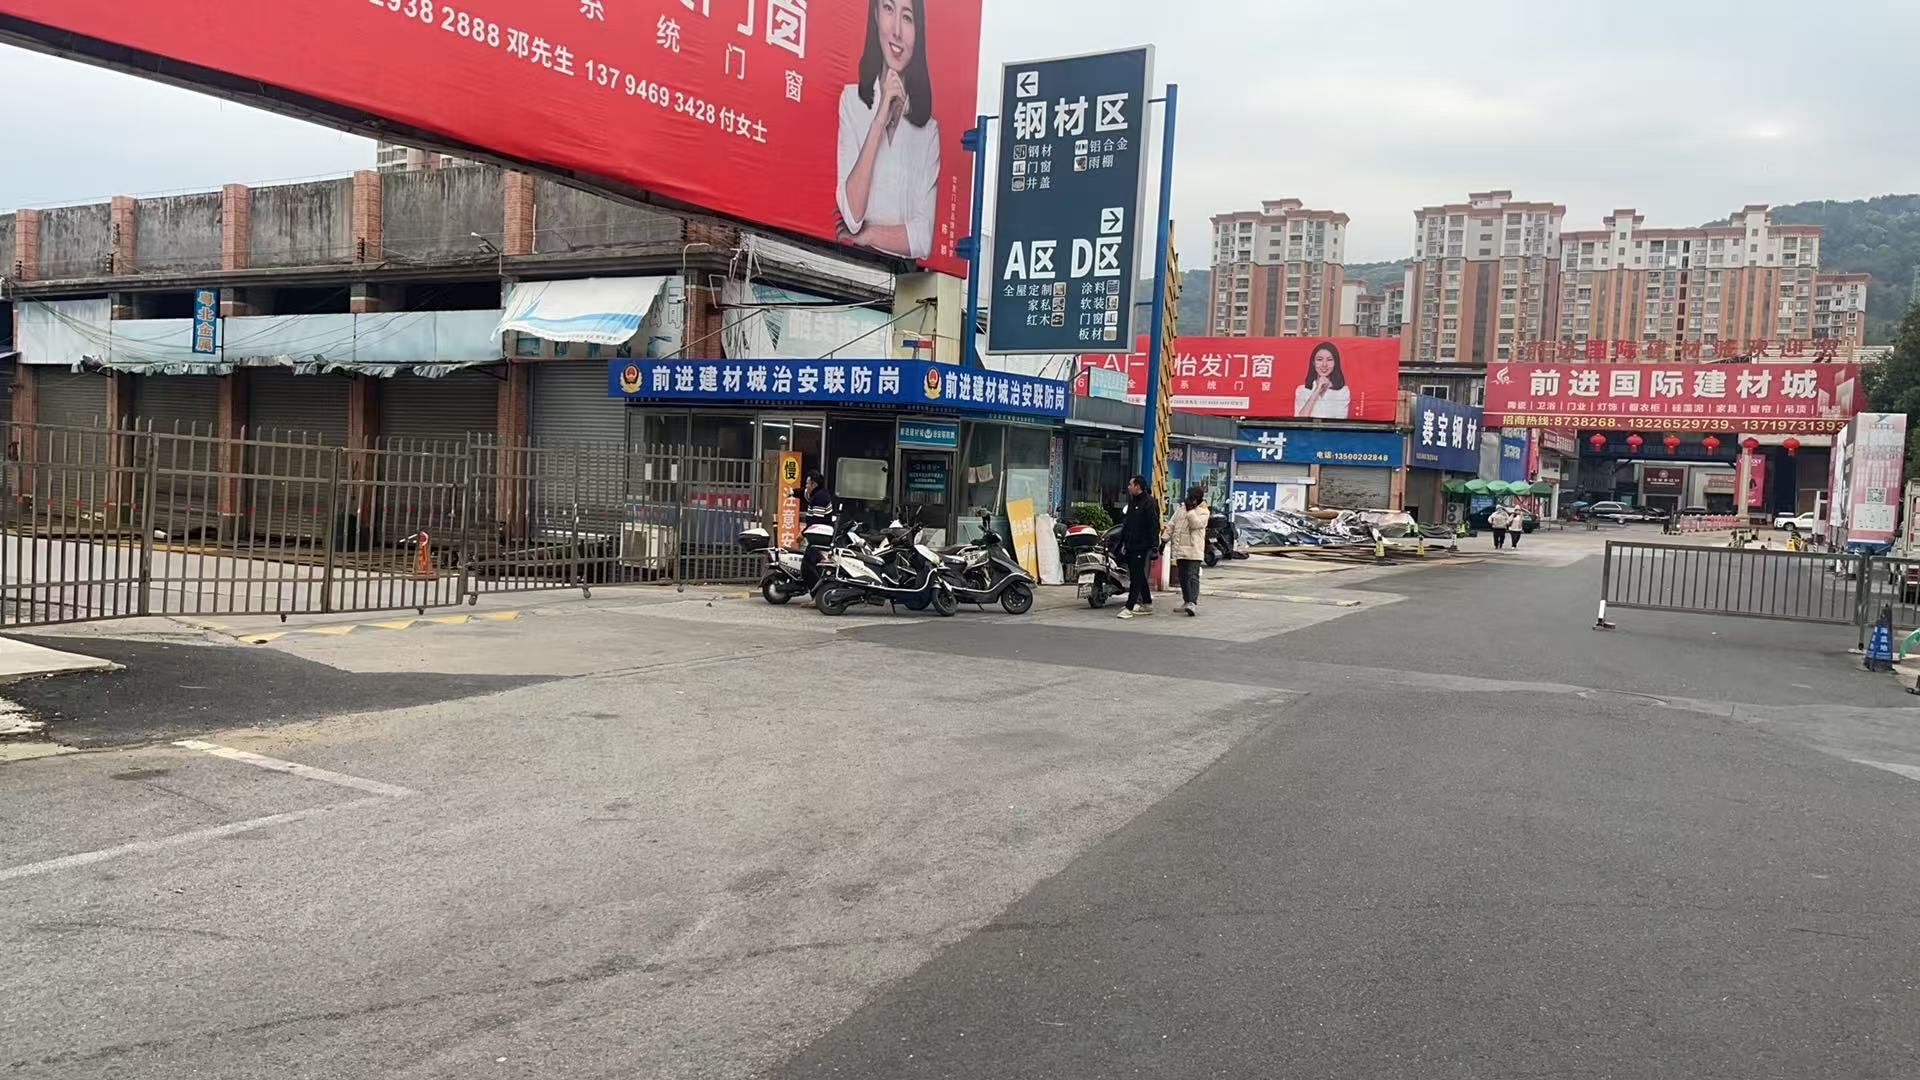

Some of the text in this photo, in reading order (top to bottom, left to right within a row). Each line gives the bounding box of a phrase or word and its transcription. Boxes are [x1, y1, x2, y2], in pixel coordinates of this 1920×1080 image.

[441, 6, 500, 47] 2888
[507, 28, 574, 76] 邓先生
[585, 60, 620, 89] 137
[625, 74, 669, 107] 9469
[675, 92, 716, 124] 3428
[720, 107, 768, 143] 付女士
[1013, 92, 1129, 140] 钢材区
[1027, 144, 1053, 158] 钢材
[1089, 137, 1129, 153] 铝合金
[1027, 160, 1052, 174] 门窗
[1003, 236, 1123, 280] A区 D区
[1003, 284, 1053, 298] 全屋定制
[1081, 282, 1106, 296] 涂料
[1027, 299, 1052, 312] 家私
[1080, 298, 1105, 311] 软装
[1026, 315, 1051, 327] 红木
[1079, 313, 1104, 326] 门窗
[1078, 328, 1103, 341] 板材
[1173, 353, 1275, 378] 怡发门窗
[652, 365, 900, 395] 前进建材城治安联防岗
[1529, 369, 1819, 399] 前进国际建材城
[945, 371, 1065, 411] 前进建材城治安联防岗
